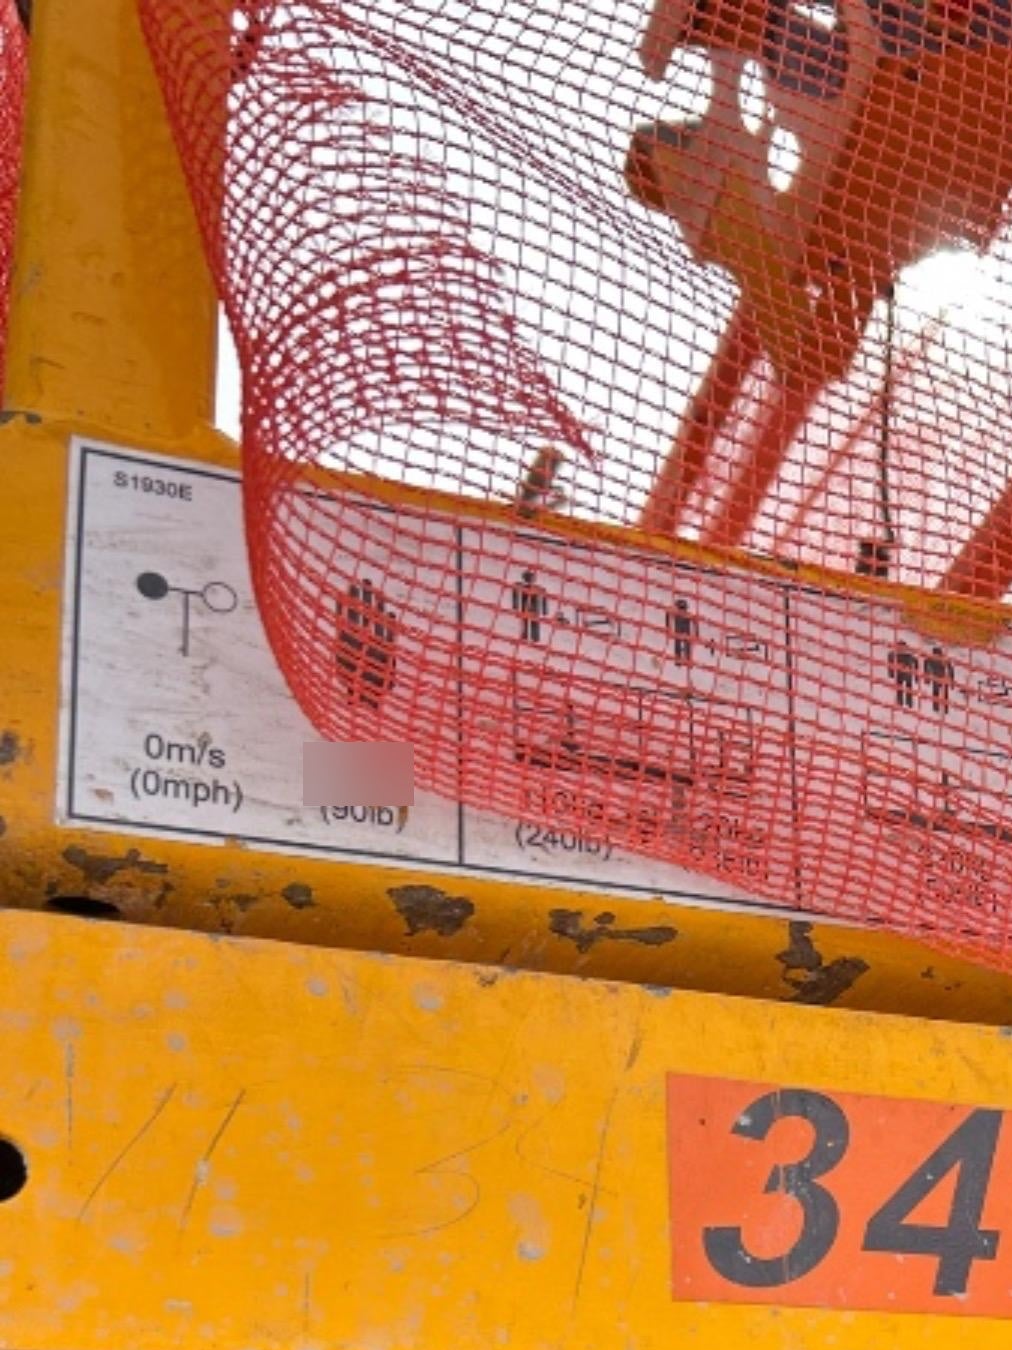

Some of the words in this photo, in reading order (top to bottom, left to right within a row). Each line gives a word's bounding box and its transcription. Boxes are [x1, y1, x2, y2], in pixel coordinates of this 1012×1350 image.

[113, 470, 194, 502] S1930E
[144, 732, 227, 769] 0m/s
[130, 769, 244, 813] (0mph)
